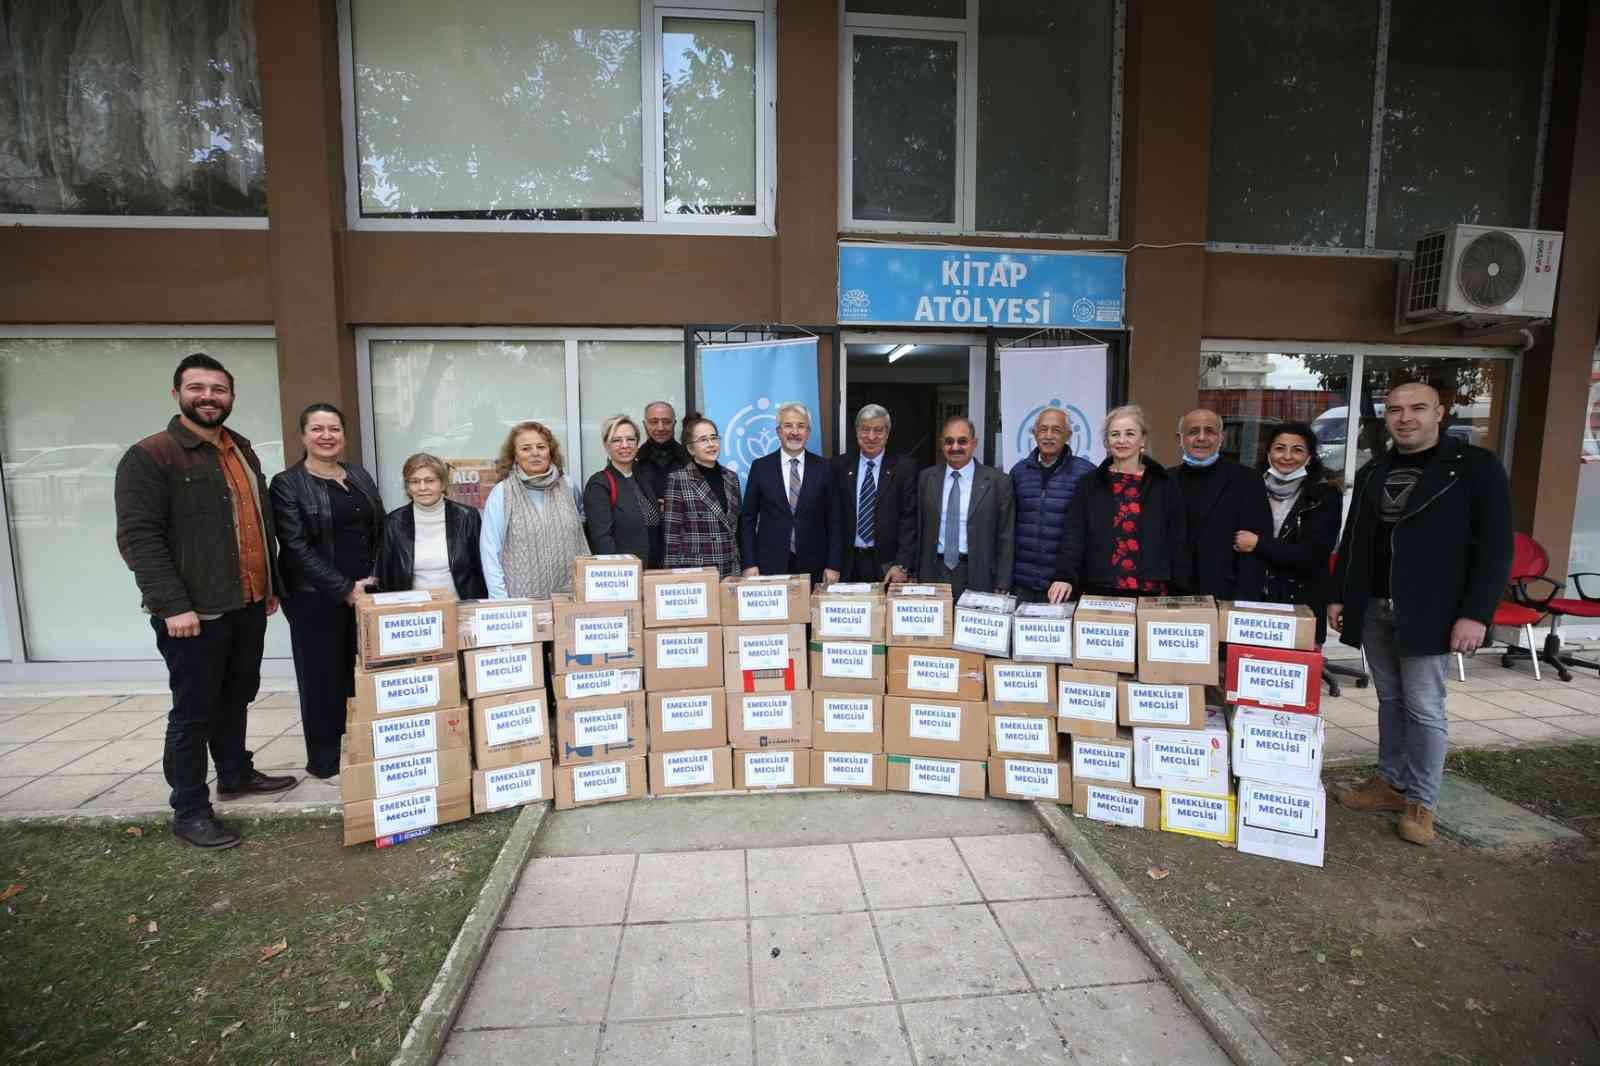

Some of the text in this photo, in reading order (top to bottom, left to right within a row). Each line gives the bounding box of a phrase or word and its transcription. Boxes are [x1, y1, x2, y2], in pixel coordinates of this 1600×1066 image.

[942, 253, 1028, 288] KİTAP
[914, 290, 1050, 323] ATÖLYESİ
[590, 569, 633, 578] EMEKLİLER
[595, 579, 629, 588] MECLİSİ
[660, 586, 702, 596] EMEKLİLER
[742, 589, 783, 598] EMEKLİLER
[665, 596, 698, 606] MECLİSİ
[747, 598, 779, 608] MECLİSİ
[481, 609, 527, 620] EMEKLİLER
[825, 606, 866, 616] EMEKLİLER
[897, 605, 939, 615] EMEKLİLER
[384, 616, 436, 629] EMEKLİLER
[830, 615, 862, 624] MECLİSİ
[901, 614, 934, 623] MECLİSİ
[961, 615, 1003, 628] EMEKLİLER
[1234, 617, 1290, 630] EMEKLİLER
[486, 620, 523, 630] MECLİSİ
[580, 622, 623, 632] EMEKLİLER
[1020, 623, 1065, 632] EMEKLİLER
[391, 626, 432, 640] MECLİSİ
[584, 631, 618, 641] MECLİSİ
[965, 625, 998, 637] MECLİSİ
[1082, 626, 1129, 637] EMEKLİLER
[1153, 627, 1204, 637] EMEKLİLER
[1239, 628, 1283, 641] MECLİSİ
[661, 636, 703, 646] EMEKLİLER
[743, 638, 784, 648] EMEKLİLER
[1025, 633, 1060, 643] MECLİSİ
[1087, 637, 1124, 647] MECLİSİ
[1158, 637, 1199, 648] MECLİSİ
[666, 645, 699, 655] MECLİSİ
[748, 647, 780, 657] MECLİSİ
[827, 647, 868, 657] EMEKLİLER
[481, 654, 527, 666] EMEKLİLER
[831, 657, 863, 666] MECLİSİ
[912, 659, 955, 670] EMEKLİLER
[486, 665, 522, 676] MECLİSİ
[571, 671, 615, 680] EMEKLİLER
[917, 669, 949, 679] MECLİSİ
[999, 669, 1042, 678] EMEKLİLER
[1244, 663, 1301, 679] EMEKLİLER
[381, 675, 433, 687] EMEKLİLER
[577, 679, 610, 690] MECLİSİ
[1004, 679, 1038, 688] MECLİSİ
[1250, 675, 1294, 689] MECLİSİ
[387, 685, 428, 698] MECLİSİ
[1064, 687, 1111, 698] EMEKLİLER
[1133, 688, 1183, 700] EMEKLİLER
[666, 701, 708, 710] EMEKLİLER
[747, 700, 787, 709] EMEKLİLER
[829, 703, 869, 711] EMEKLİLER
[1069, 697, 1106, 708] MECLİSİ
[1139, 699, 1178, 710] MECLİSİ
[490, 706, 536, 720] EMEKLİLER
[671, 709, 703, 718] MECLİSİ
[752, 708, 783, 717] MECLİSİ
[833, 711, 864, 720] MECLİSİ
[915, 708, 956, 719] EMEKLİLER
[497, 717, 533, 731] MECLİSİ
[580, 713, 623, 724] EMEKLİLER
[920, 718, 952, 728] MECLİSİ
[378, 719, 430, 733] EMEKLİLER
[584, 723, 618, 733] MECLİSİ
[1000, 721, 1043, 730] EMEKLİLER
[385, 730, 425, 743] MECLİSİ
[1005, 731, 1039, 741] MECLİSİ
[1250, 726, 1306, 742] EMEKLİLER
[1155, 743, 1205, 757] EMEKLİLER
[1256, 739, 1300, 753] MECLİSİ
[1079, 747, 1125, 759] EMEKLİLER
[380, 757, 432, 772] EMEKLİLER
[668, 756, 708, 765] EMEKLİLER
[750, 755, 789, 765] EMEKLİLER
[828, 757, 869, 765] EMEKLİLER
[1084, 757, 1120, 769] MECLİSİ
[1161, 754, 1200, 767] MECLİSİ
[578, 766, 622, 778] EMEKLİLER
[672, 765, 704, 774] MECLİSİ
[754, 764, 785, 774] MECLİSİ
[832, 764, 864, 773] MECLİSİ
[914, 763, 955, 774] EMEKLİLER
[1009, 764, 1052, 775] EMEKLİLER
[386, 768, 427, 781] MECLİSİ
[490, 768, 536, 783] EMEKLİLER
[918, 773, 950, 782] MECLİSİ
[1015, 774, 1049, 785] MECLİSİ
[496, 779, 532, 793] MECLİSİ
[583, 775, 617, 787] MECLİSİ
[379, 795, 431, 812] EMEKLİLER
[1092, 791, 1139, 805] EMEKLİLER
[1171, 797, 1223, 810] EMEKLİLER
[1253, 791, 1310, 808] EMEKLİLER
[1097, 802, 1134, 815] MECLİSİ
[1258, 804, 1303, 819] MECLİSİ
[386, 807, 426, 822] MECLİSİ
[1177, 808, 1217, 821] MECLİSİ
